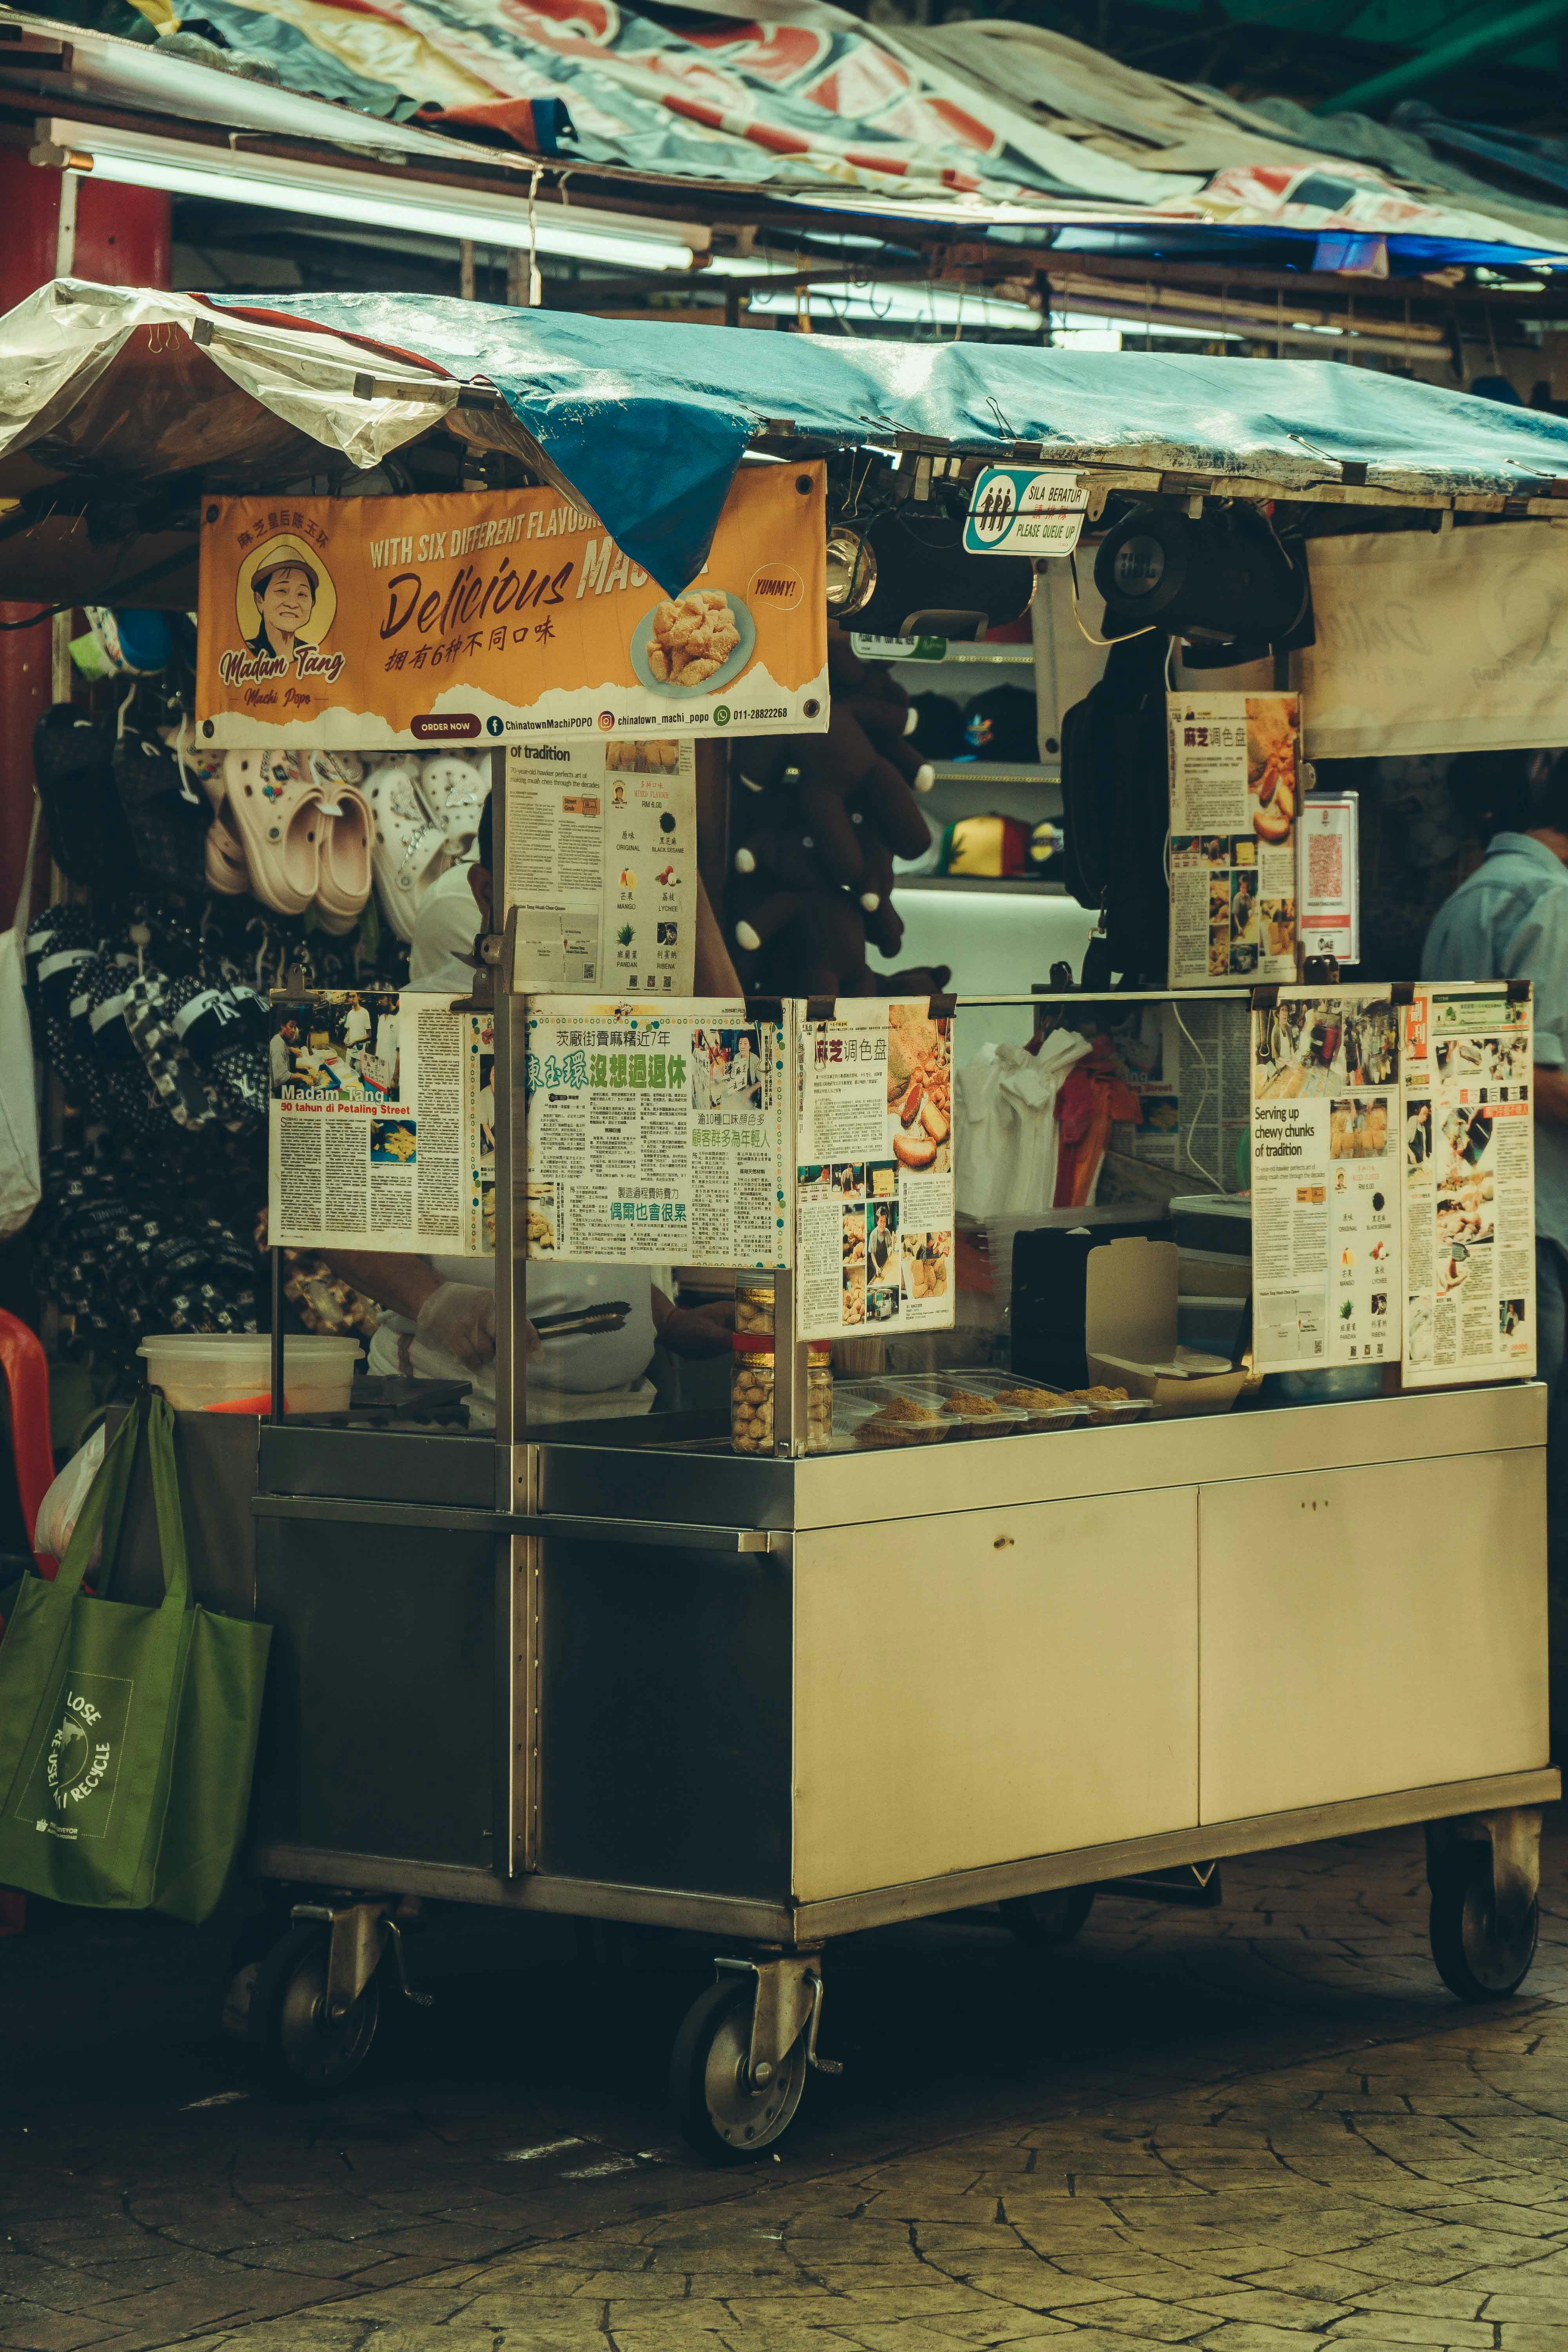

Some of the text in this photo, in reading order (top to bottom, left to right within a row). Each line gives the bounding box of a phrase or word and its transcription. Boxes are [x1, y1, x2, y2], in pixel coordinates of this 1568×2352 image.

[1029, 486, 1082, 503] SILA BERATUR
[237, 510, 329, 549] 麻芝皇后陈玉环
[370, 506, 602, 568] WITH SIX DIFFERENT FLAVOU
[1016, 524, 1075, 539] PLEASE QUEUE UP
[755, 579, 796, 597] YUMMY!
[380, 556, 574, 640] Delicious
[384, 615, 556, 672] 拥有6种不同口味
[220, 645, 345, 684] Madam Tang
[245, 687, 311, 708] Machi Popo
[617, 713, 709, 727] chinatown_machi_popo
[733, 708, 788, 720] 011-28822268
[421, 722, 470, 731] ORDER NOW
[505, 718, 593, 732] ChinatownMachiPOPO
[1184, 726, 1246, 747] 麻芝调色盘
[510, 744, 570, 761] of tradition
[510, 767, 537, 777] 70-year-old
[510, 777, 526, 785] making
[554, 779, 572, 788] through
[621, 831, 635, 840] 原味
[659, 837, 677, 845] 黑芝麻
[620, 892, 634, 901] 芒果
[556, 1030, 671, 1047] 茨廠街賣麻糬近7年
[815, 1037, 887, 1063] 麻芝调色盘
[281, 1085, 385, 1106] Madam Tang
[281, 1102, 410, 1115] 50 tahun di Petaling Street
[1255, 1106, 1299, 1122] Serving up
[691, 1129, 770, 1148] 顧客群多為年輕人
[1255, 1123, 1314, 1141] chewy chunks
[1255, 1142, 1302, 1157] of tradition
[617, 1187, 679, 1200] 製造過程費時費力
[610, 1202, 687, 1221] 偶爾也會很累
[70, 1742, 110, 1802] RECYCLE
